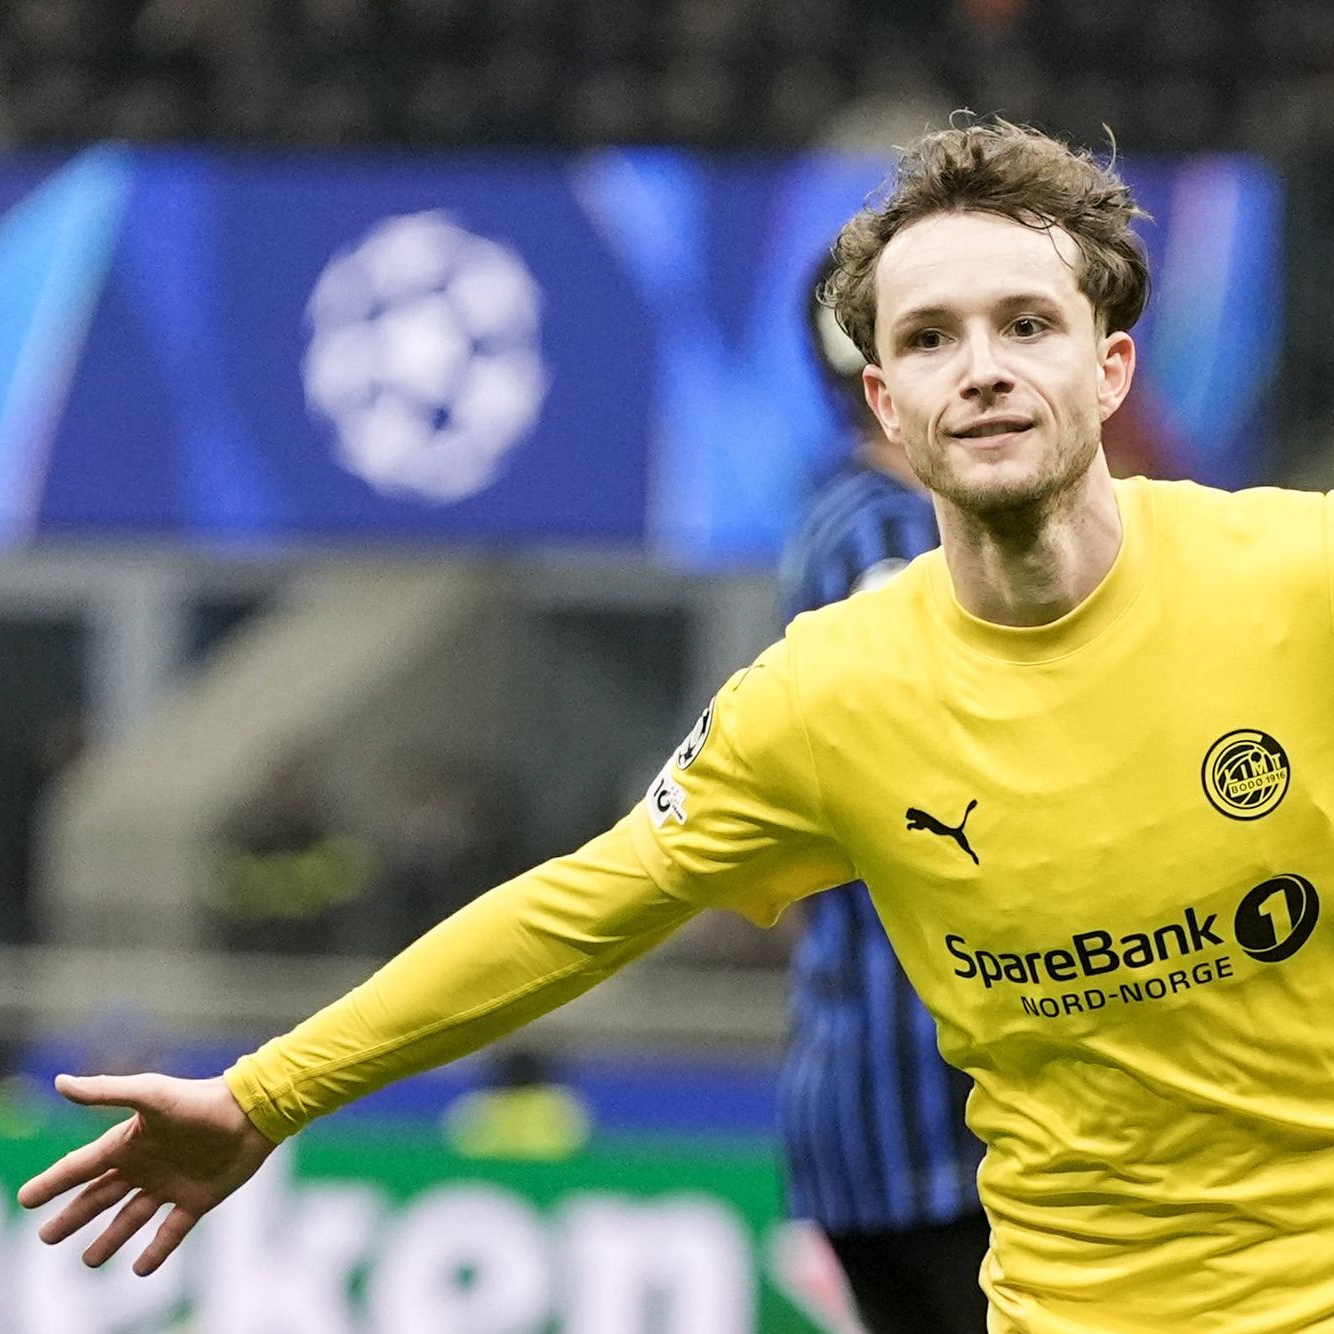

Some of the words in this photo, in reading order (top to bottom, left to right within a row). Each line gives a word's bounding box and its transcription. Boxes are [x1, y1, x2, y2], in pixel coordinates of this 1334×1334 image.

[1266, 771, 1286, 784] 1916
[946, 907, 1224, 987] SpareBank
[1021, 956, 1234, 1018] NORD-NORGE
